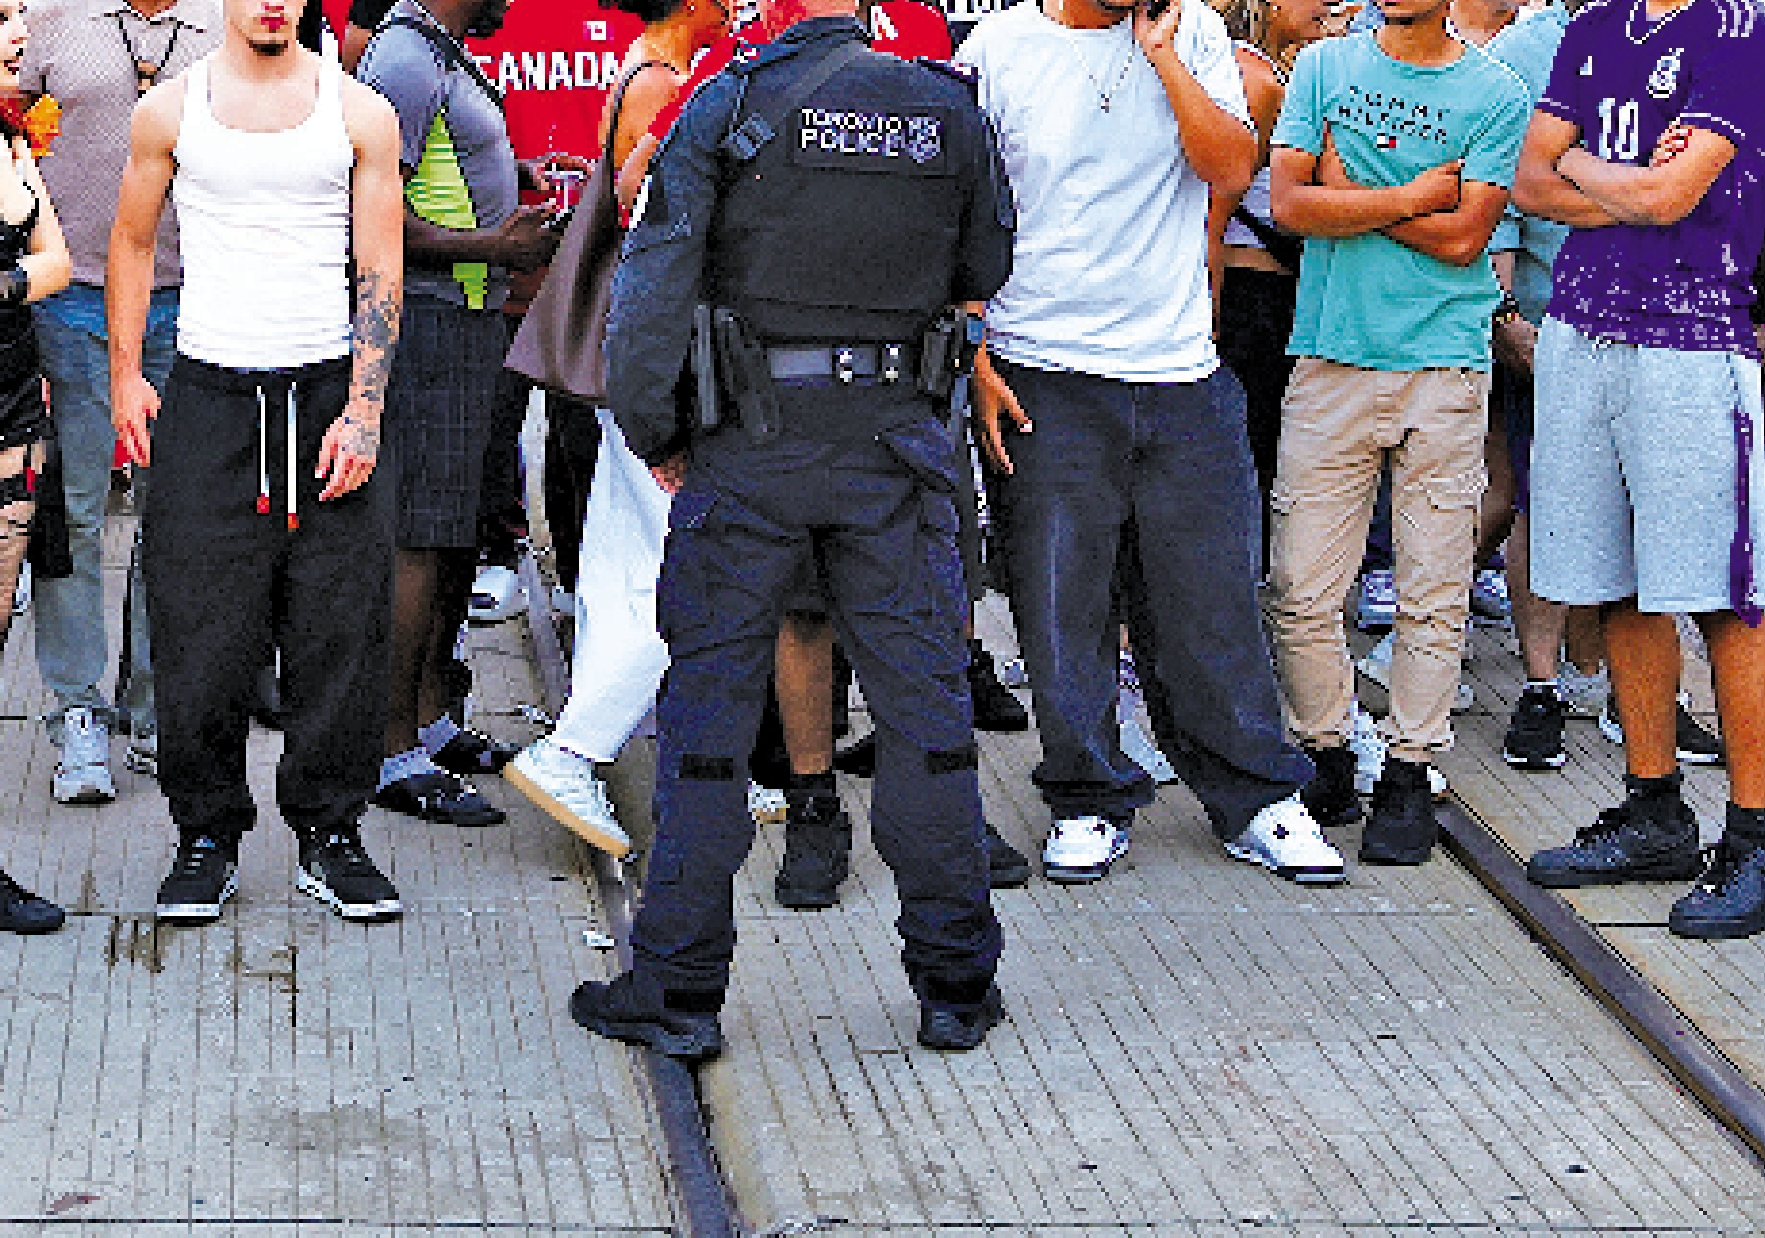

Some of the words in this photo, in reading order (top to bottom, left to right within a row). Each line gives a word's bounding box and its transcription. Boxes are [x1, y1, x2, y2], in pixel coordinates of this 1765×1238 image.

[472, 51, 620, 91] CANADA
[801, 108, 902, 134] TORONTO
[1599, 97, 1639, 160] 10
[801, 128, 900, 157] POLICE
